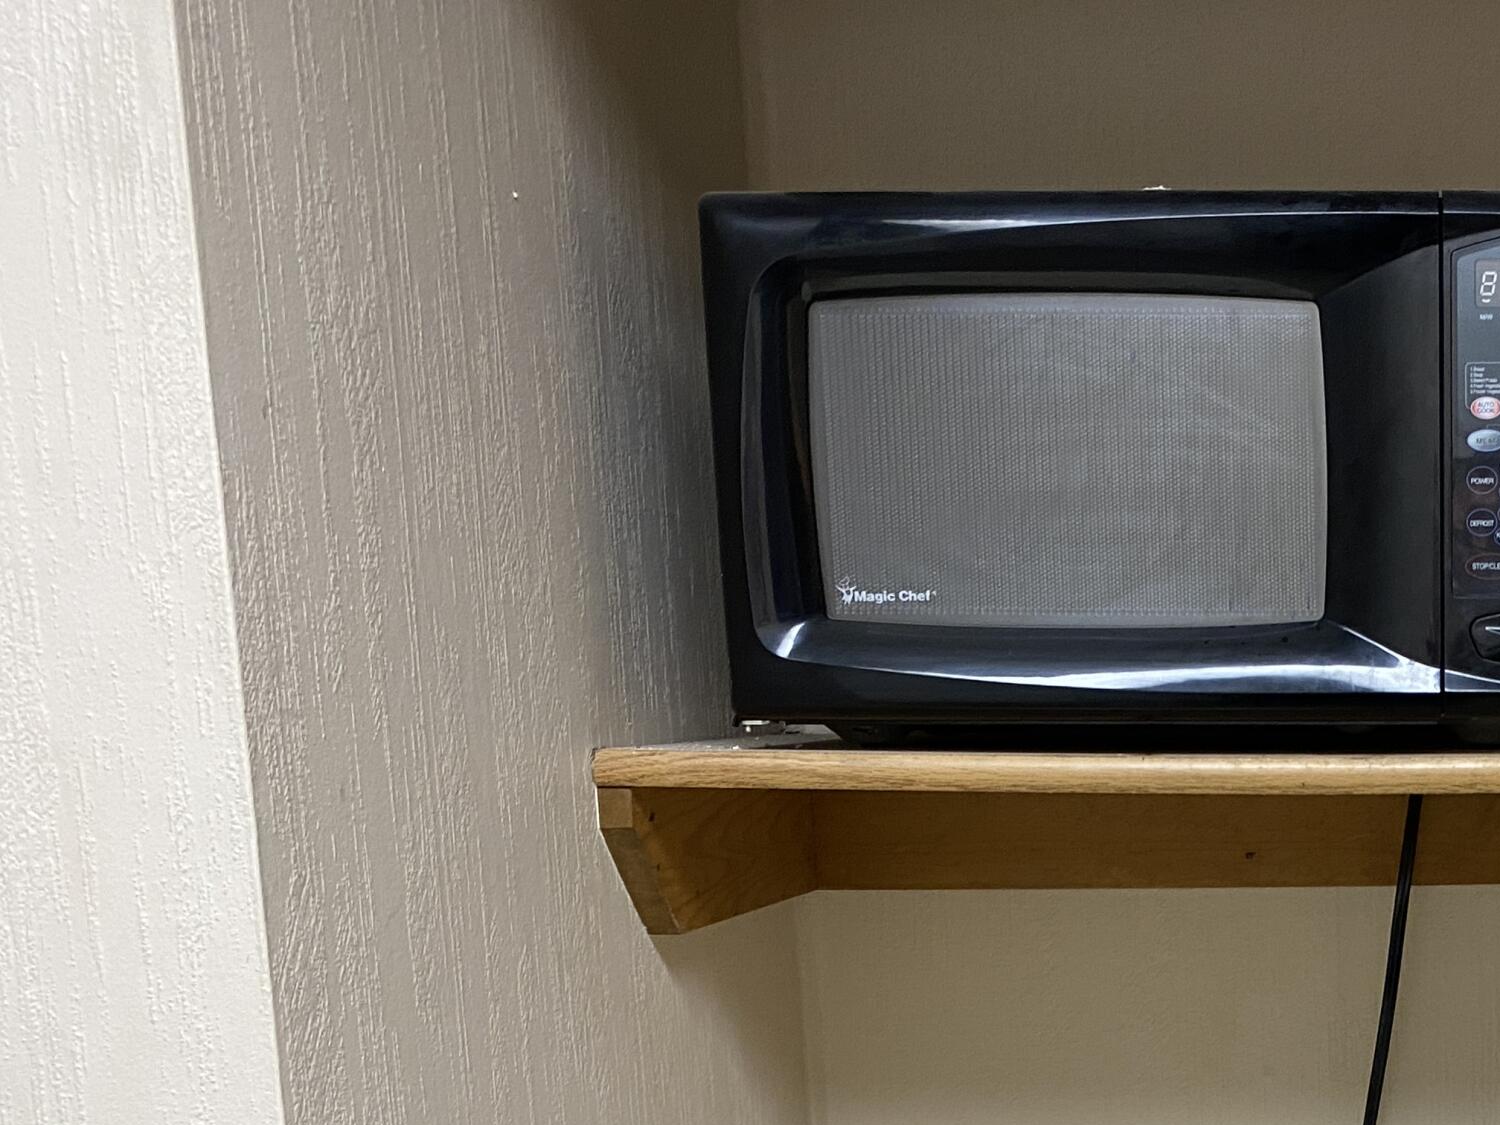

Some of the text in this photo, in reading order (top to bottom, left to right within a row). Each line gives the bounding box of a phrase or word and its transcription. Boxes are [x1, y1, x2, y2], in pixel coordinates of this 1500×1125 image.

[1470, 477, 1494, 485] POWER
[1469, 520, 1494, 528] DEFROST
[854, 590, 896, 604] Magic
